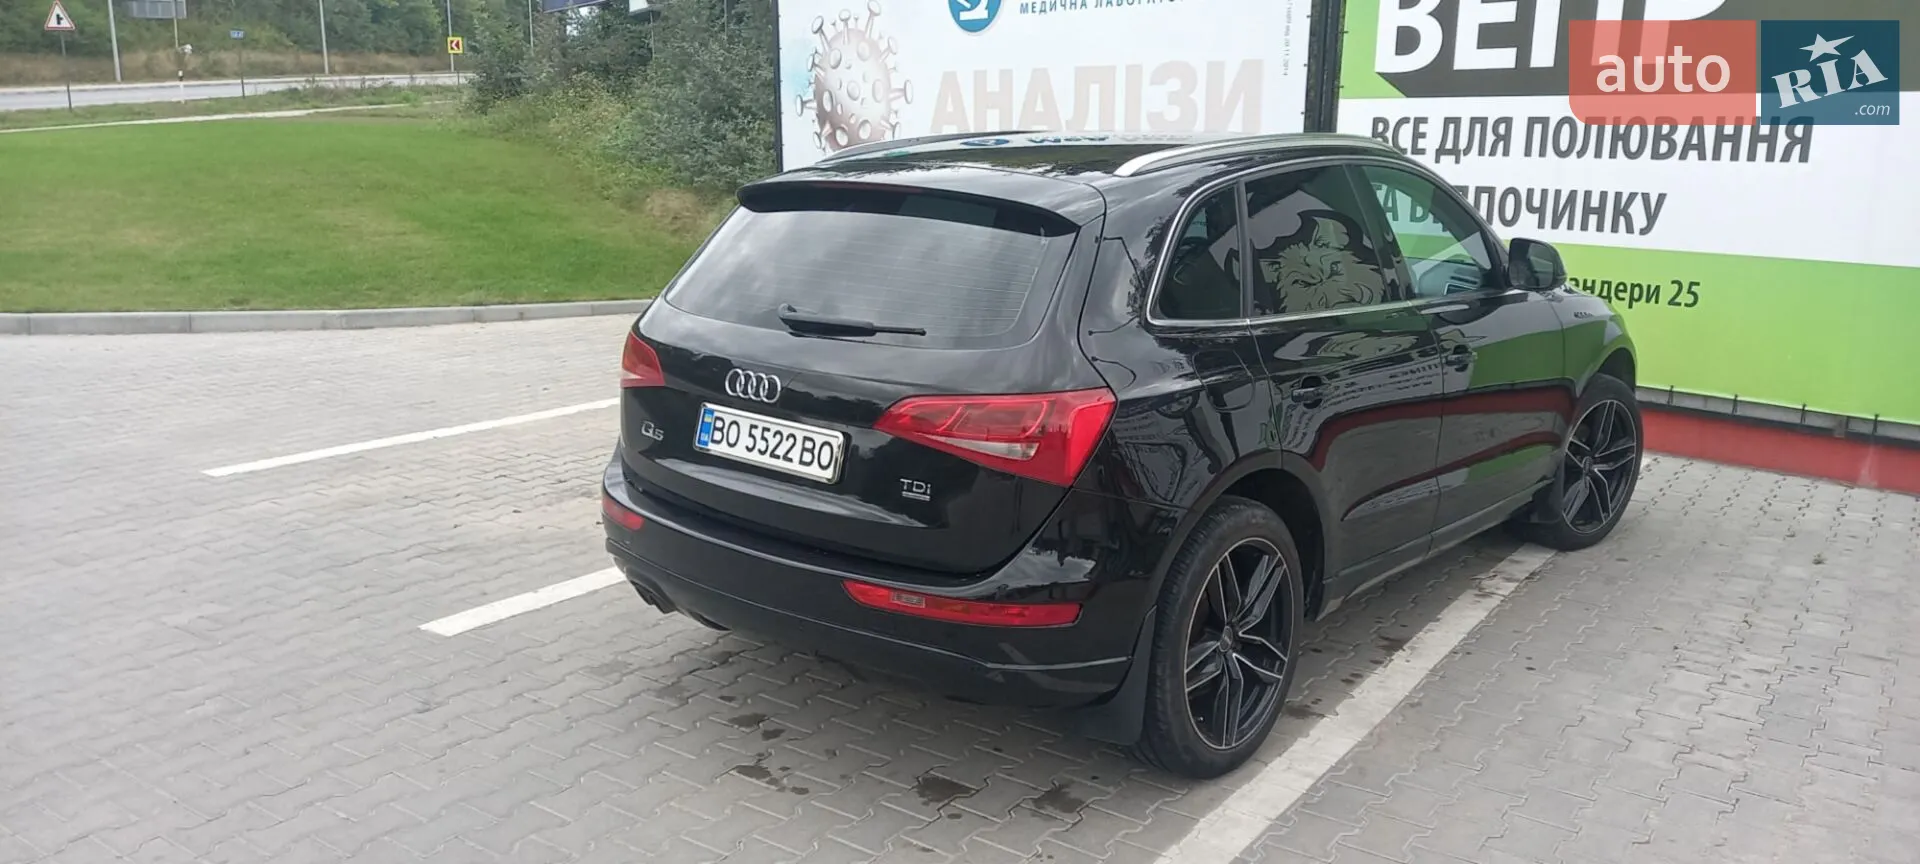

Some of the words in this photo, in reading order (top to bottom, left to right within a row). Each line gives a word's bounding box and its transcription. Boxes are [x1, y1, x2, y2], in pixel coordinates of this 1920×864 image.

[1019, 0, 1088, 15] МЕДИЧНА
[929, 59, 1265, 134] АНАЛІЗИ
[1371, 117, 1429, 156] ВСЕ
[1434, 117, 1514, 165] ДЛЯ
[1523, 115, 1815, 163] ПОЛЮВАННЯ
[1667, 279, 1701, 308] 25
[710, 416, 740, 448] BO
[745, 423, 797, 463] 5522
[798, 435, 834, 471] BO
